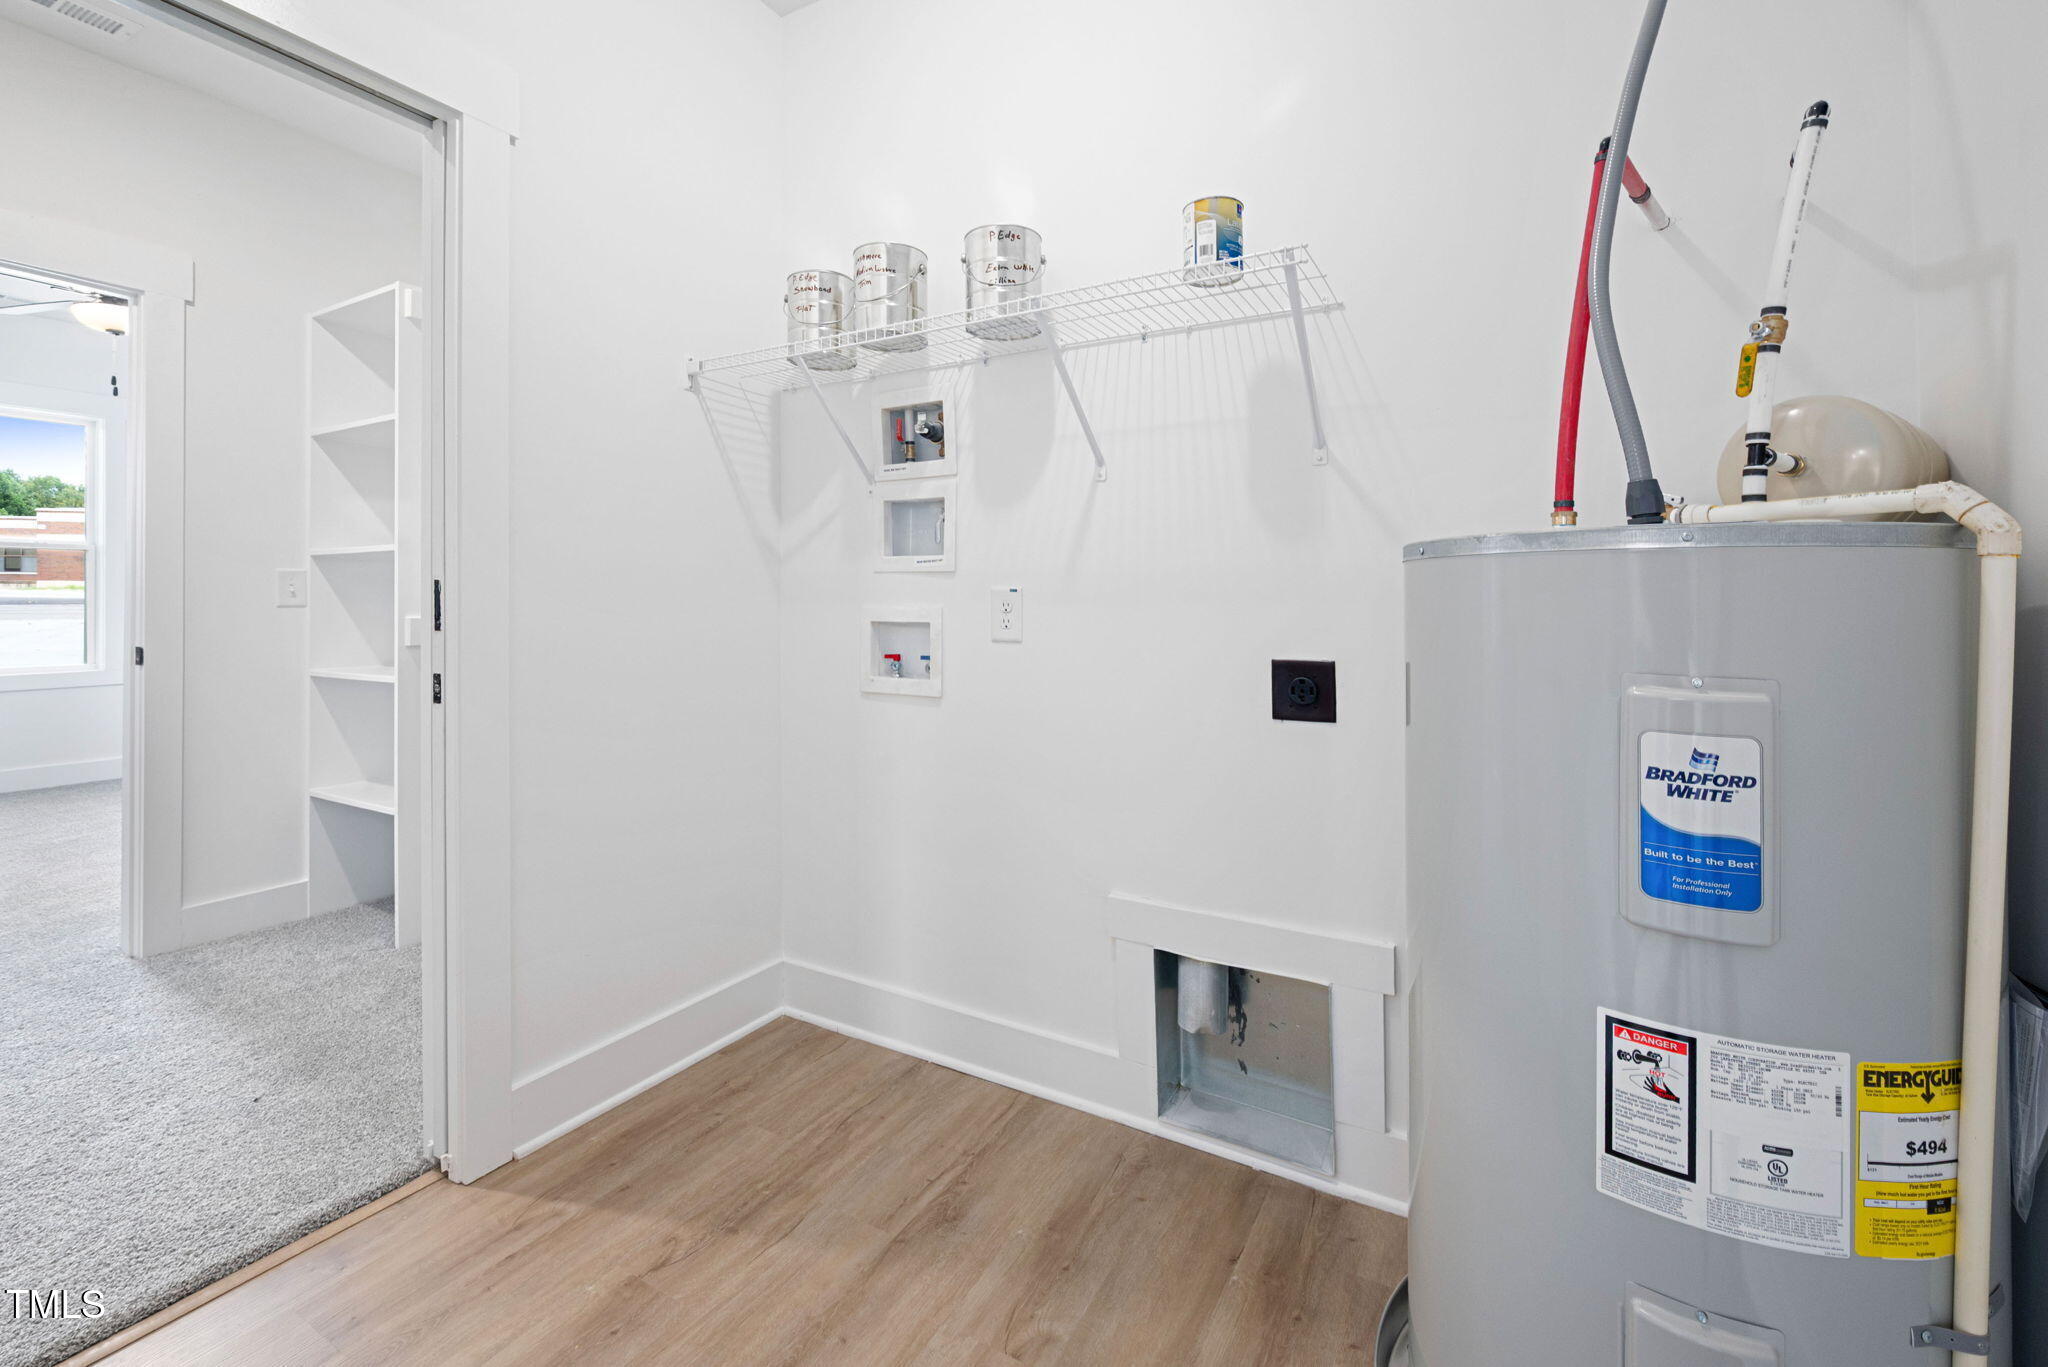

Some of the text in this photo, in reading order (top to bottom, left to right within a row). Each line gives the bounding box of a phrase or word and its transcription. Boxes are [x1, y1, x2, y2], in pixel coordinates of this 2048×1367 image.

[1645, 765, 1757, 789] BRADFORD
[1666, 783, 1734, 803] WHITE
[1644, 847, 1755, 869] Built to be the Best
[1672, 876, 1731, 889] For Professional
[1672, 883, 1733, 898] Installation Only
[1632, 1032, 1679, 1052] DANGER
[1717, 1040, 1836, 1061] AUTOMATIC STORAGE WATER HEATER
[1649, 1069, 1667, 1078] HOT
[1863, 1067, 1962, 1088] ENERGYGUID
[1905, 1138, 1948, 1157] $494
[1767, 1175, 1788, 1185] LISTED
